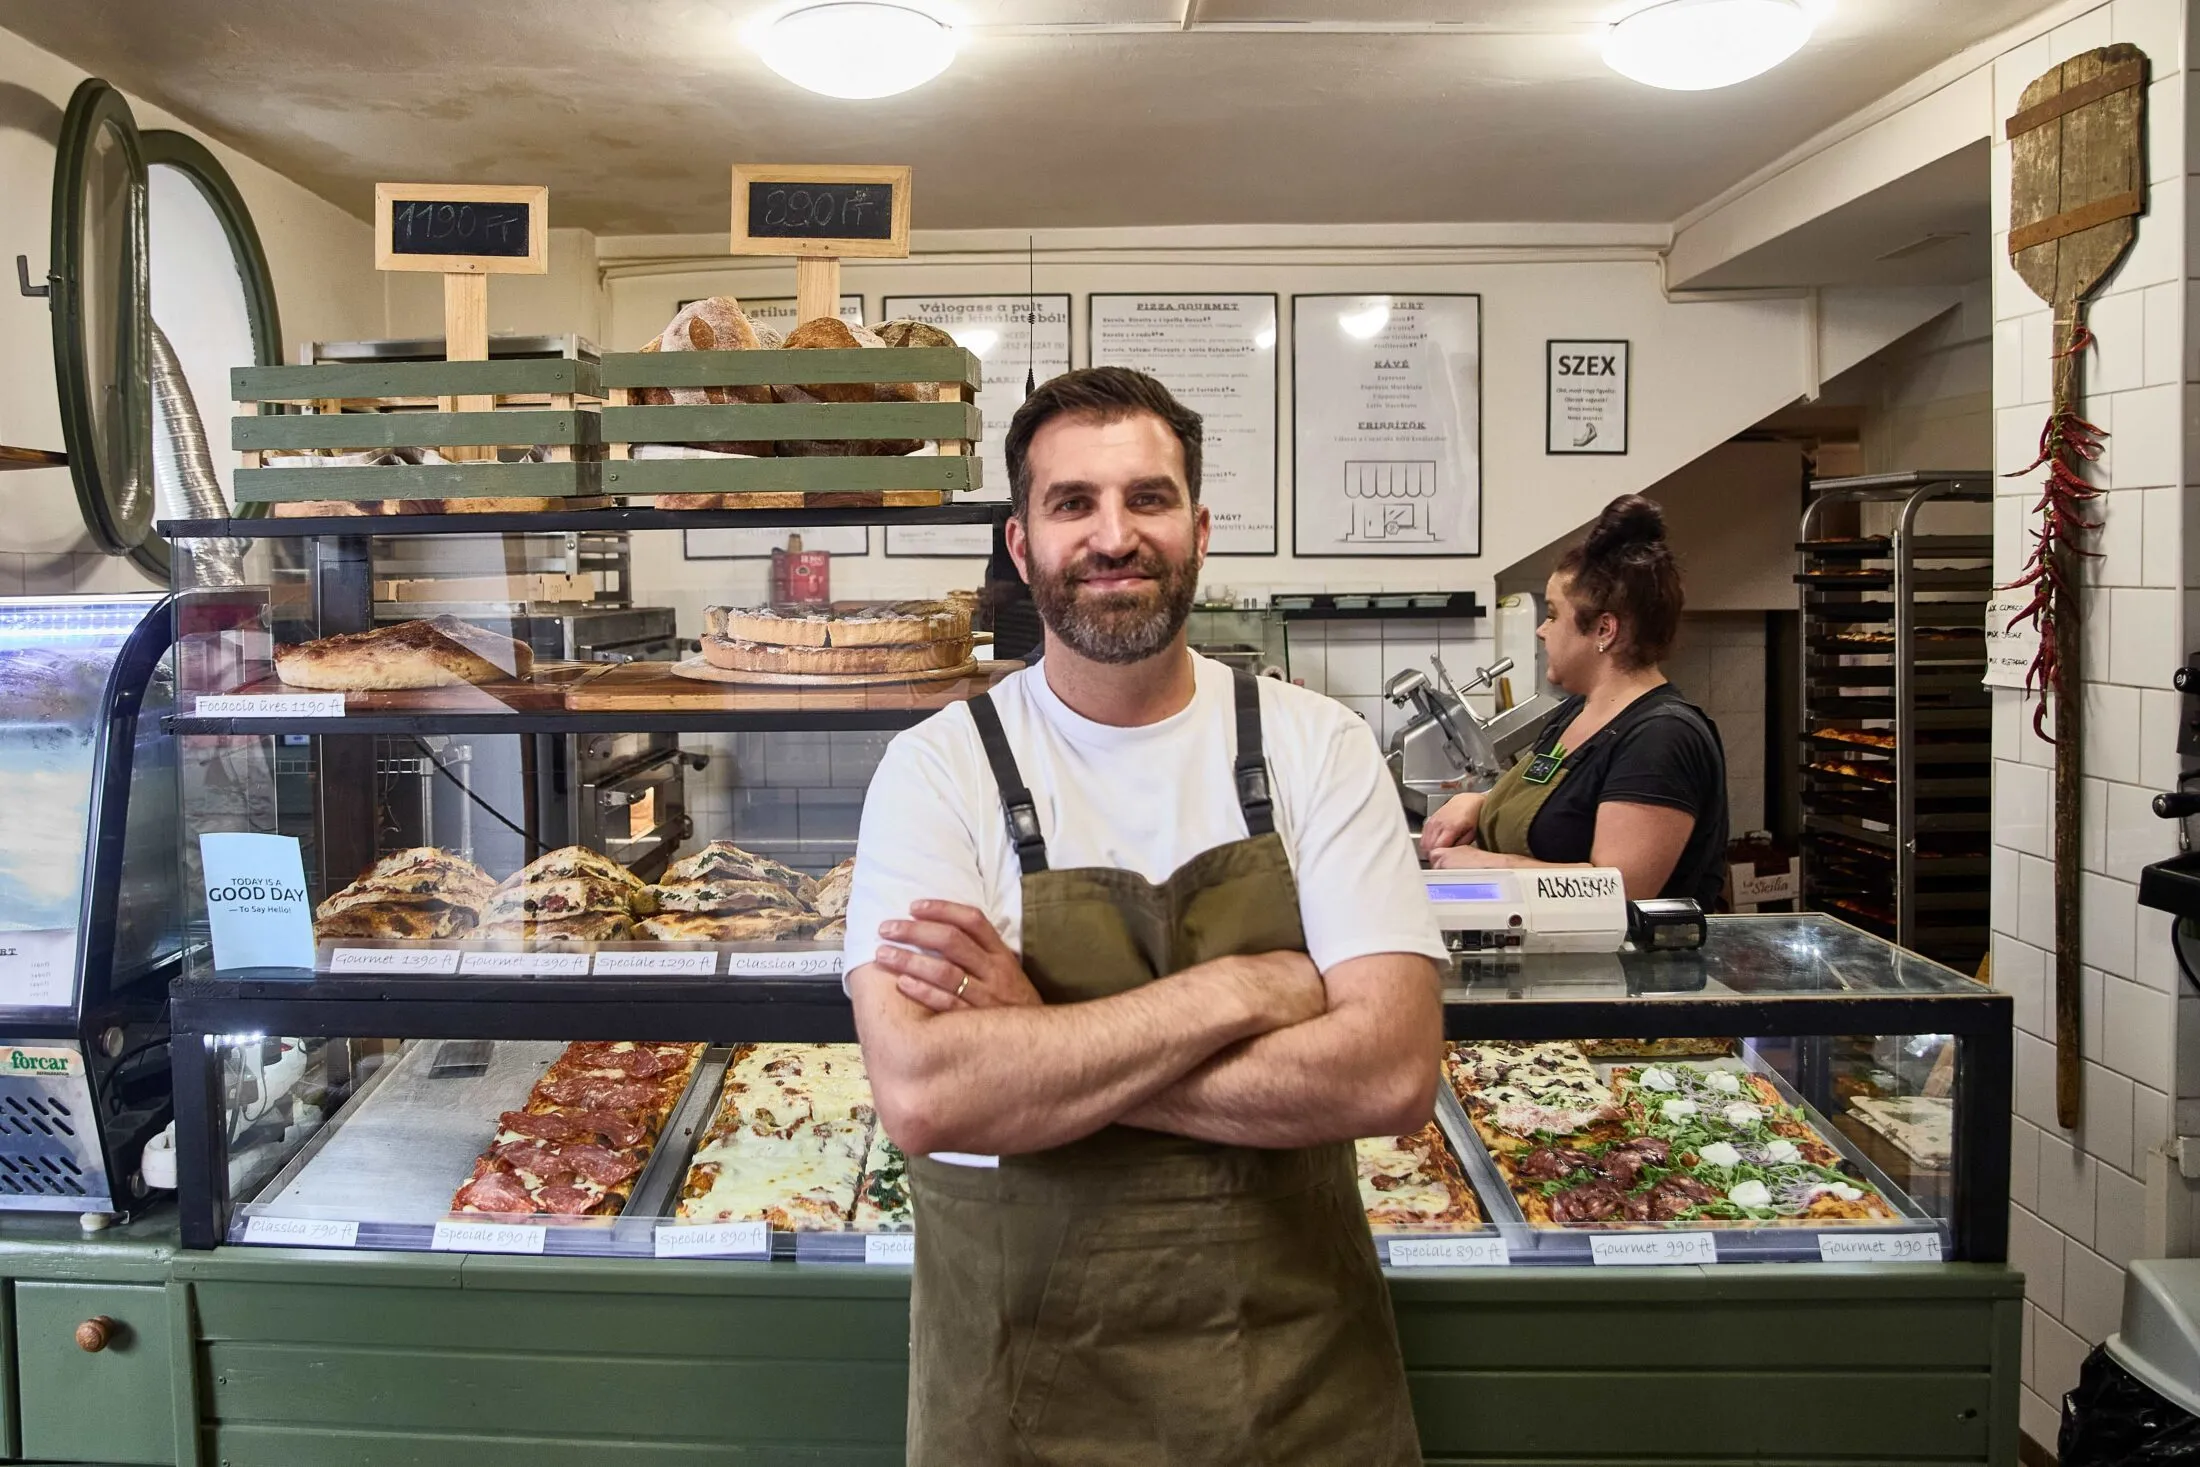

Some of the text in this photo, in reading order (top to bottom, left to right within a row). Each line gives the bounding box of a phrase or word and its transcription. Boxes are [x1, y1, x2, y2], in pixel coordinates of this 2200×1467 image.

[399, 203, 476, 238] 1190
[920, 302, 1043, 315] Válogass a pult
[1558, 355, 1616, 376] SZEX
[199, 700, 255, 713] Focaccia
[291, 702, 325, 717] 1190
[231, 878, 282, 887] TODAY IS A
[209, 886, 304, 902] GOOD DAY
[251, 905, 265, 914] Say
[267, 905, 292, 914] Hello!
[335, 953, 394, 965] Gourmet
[402, 955, 438, 968] 1390
[464, 956, 523, 967] Gourmet
[597, 956, 655, 971] Speciale
[736, 957, 796, 969] Classica
[797, 959, 828, 973] 990
[11, 1050, 69, 1070] forcar
[251, 1220, 306, 1234] Classica
[310, 1224, 338, 1239] 790
[438, 1226, 494, 1243] Speciale
[496, 1230, 523, 1246] 890
[660, 1231, 716, 1250] Speciale
[720, 1230, 747, 1247] 890
[870, 1239, 914, 1257] Speci
[1594, 1241, 1658, 1256] Gourmet
[1664, 1240, 1694, 1258] 990
[1821, 1240, 1886, 1255] Gourmet
[1891, 1239, 1922, 1257] 990
[1391, 1244, 1453, 1262] Speciale
[1456, 1244, 1484, 1262] 890
